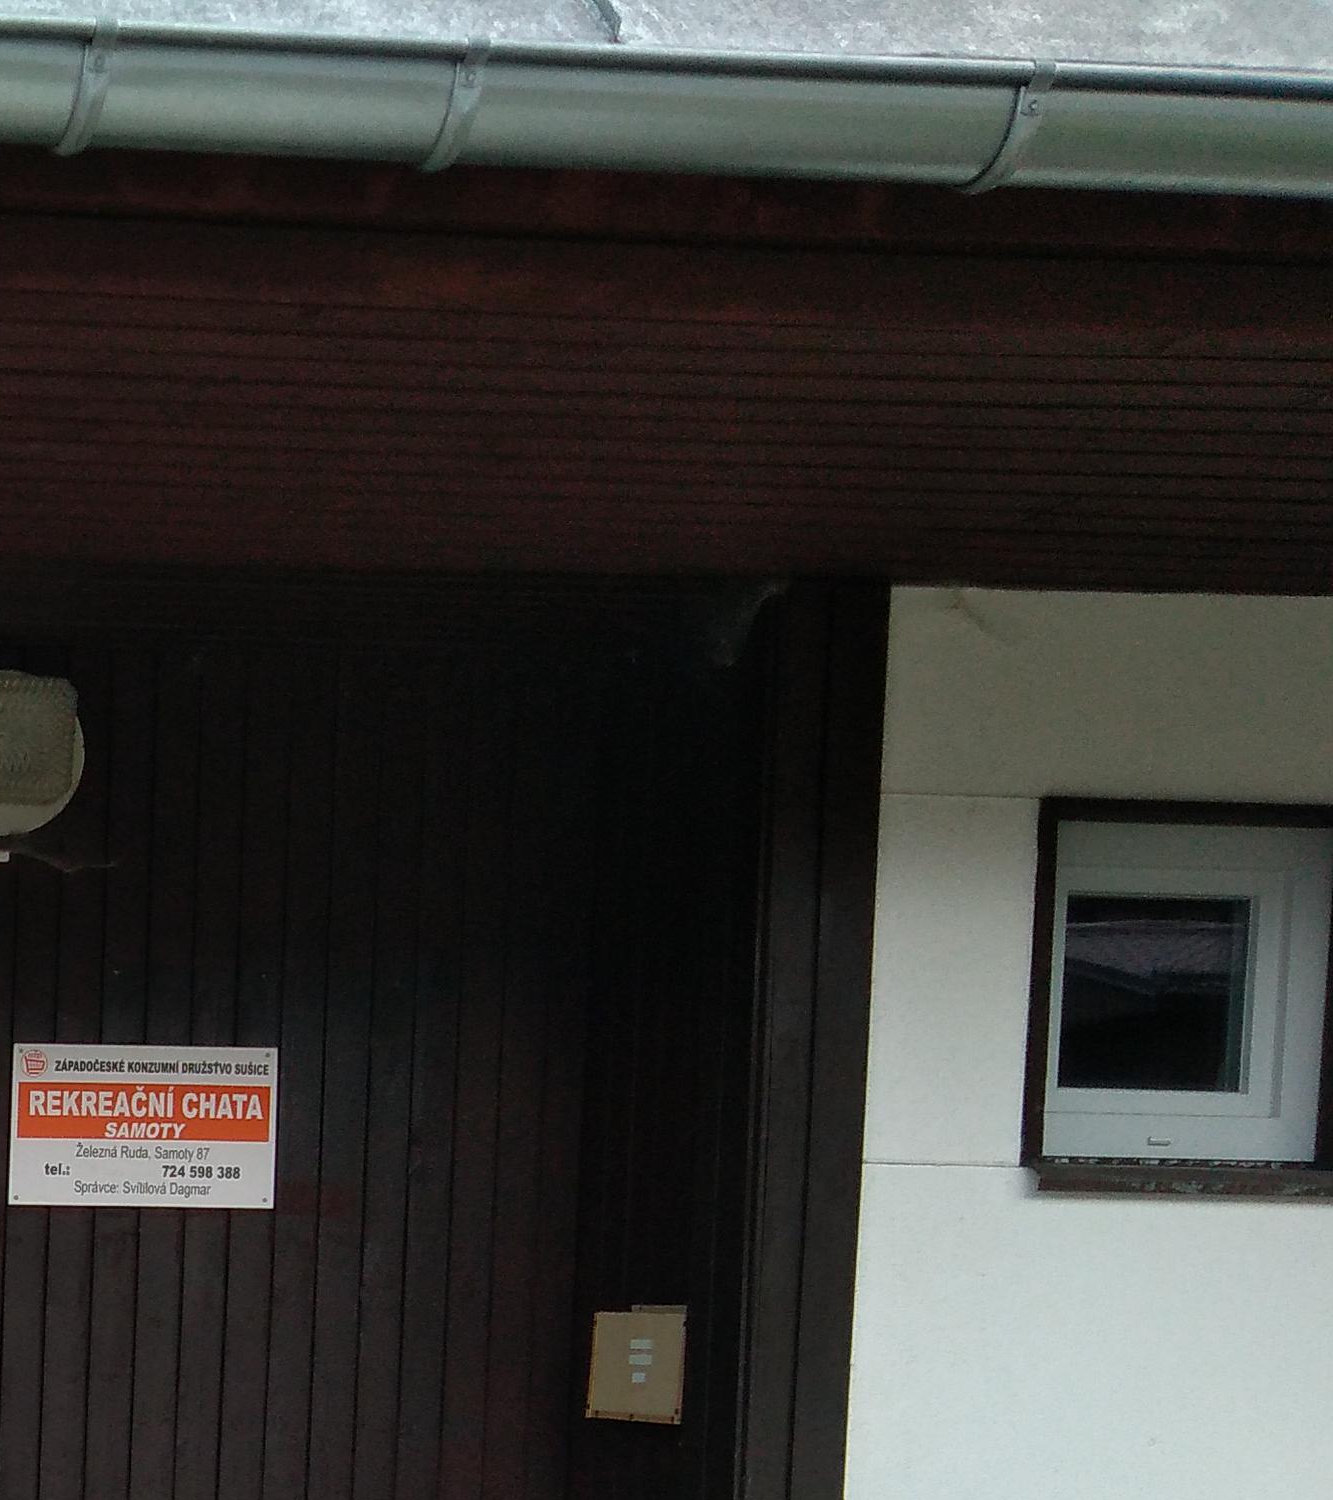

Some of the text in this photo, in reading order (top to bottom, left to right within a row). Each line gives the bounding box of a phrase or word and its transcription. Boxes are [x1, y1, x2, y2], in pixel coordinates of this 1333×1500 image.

[54, 1059, 125, 1073] ZÁPADOČESKÉ
[127, 1061, 179, 1074] KONZUMNÍ
[234, 1062, 269, 1076] SUŠICE
[29, 1086, 264, 1120] REKREAČNÍ CHATA
[104, 1122, 186, 1139] SAMOTY
[76, 1142, 117, 1158] Železná
[154, 1146, 194, 1161] Samoty
[196, 1148, 210, 1160] 87
[44, 1163, 240, 1179] tel.: 724 598 388
[74, 1180, 119, 1195] Správce:
[169, 1182, 211, 1198] Dagmar
